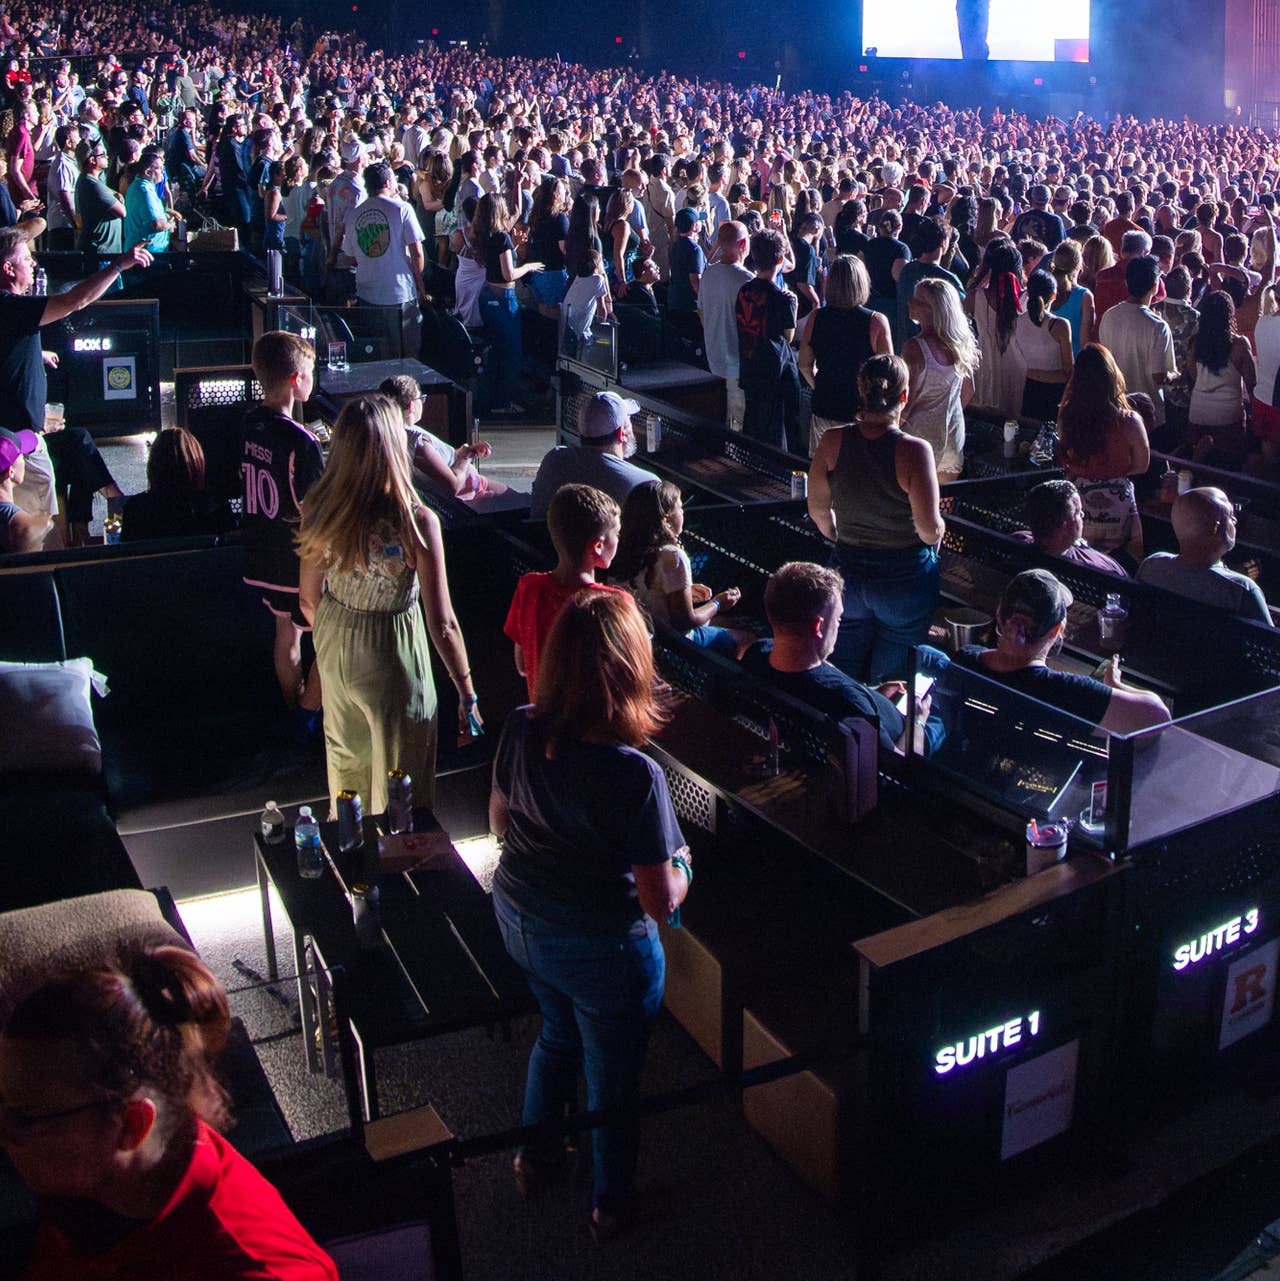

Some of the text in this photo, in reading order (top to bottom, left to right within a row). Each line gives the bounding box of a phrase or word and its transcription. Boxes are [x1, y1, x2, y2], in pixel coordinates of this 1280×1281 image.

[74, 338, 100, 351] BOX
[244, 440, 272, 464] MESSI
[240, 462, 279, 520] 10
[1173, 908, 1259, 971] SUITE 3
[935, 1010, 1040, 1076] SUITE 1
